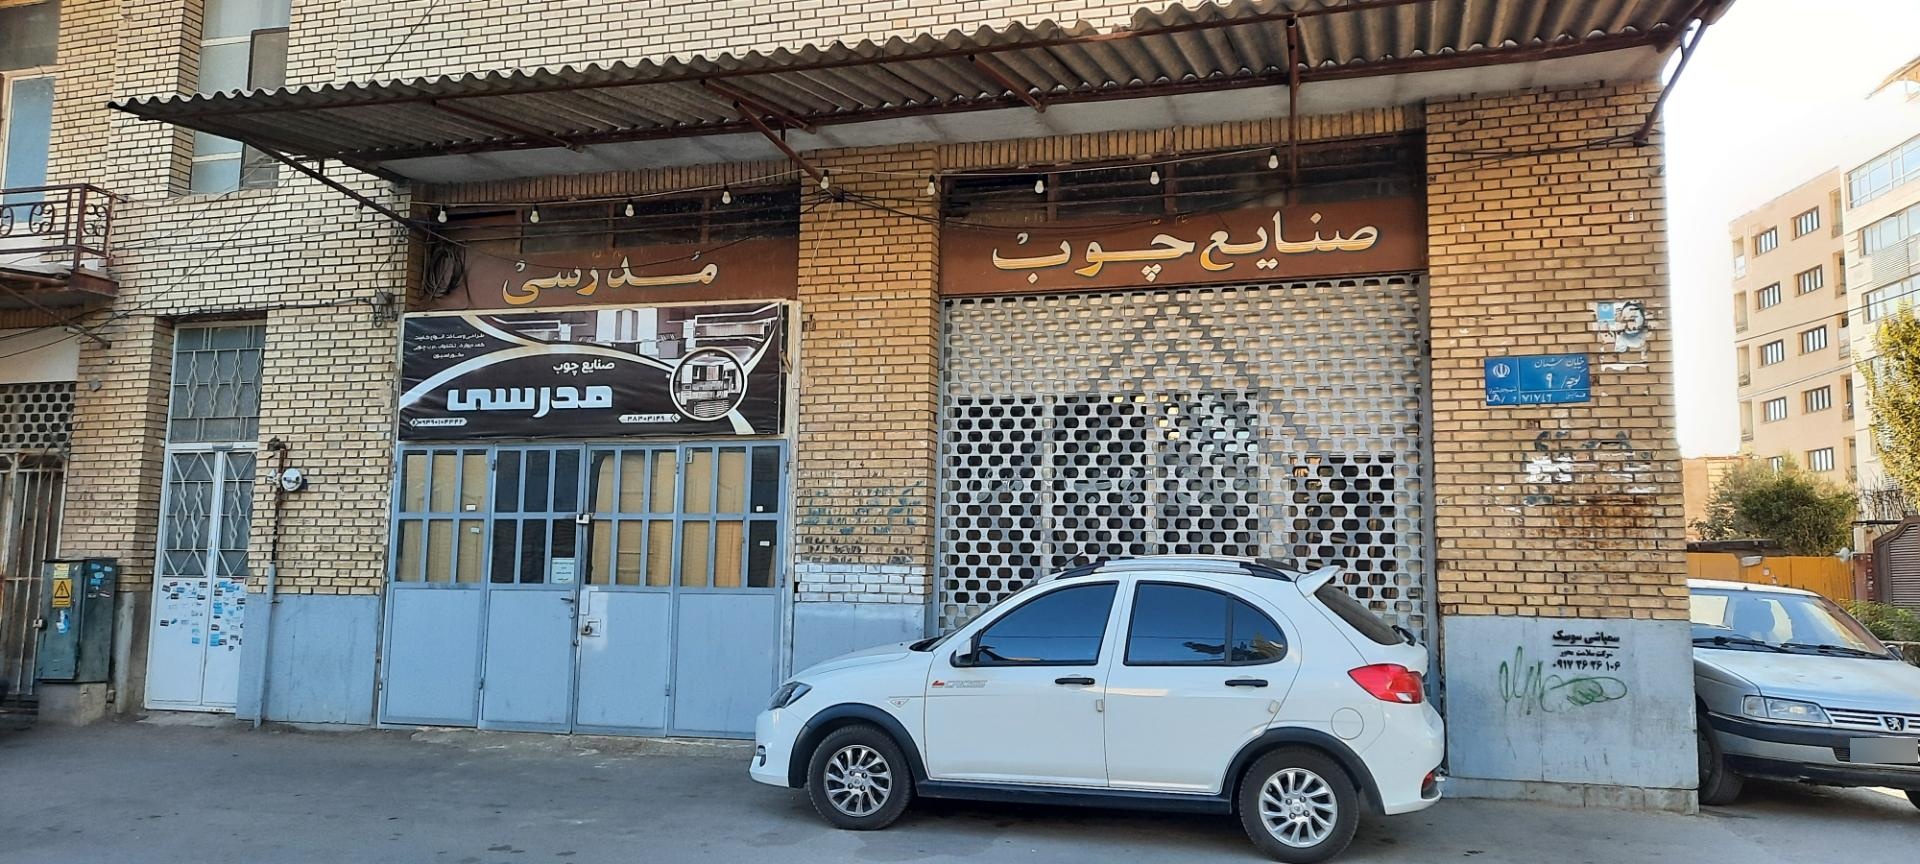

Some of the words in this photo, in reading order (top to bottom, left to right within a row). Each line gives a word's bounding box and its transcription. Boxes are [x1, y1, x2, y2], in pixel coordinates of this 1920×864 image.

[1199, 211, 1380, 272] صنایع
[992, 232, 1197, 284] چوب
[552, 362, 580, 377] چوب
[582, 358, 616, 374] صنایع
[447, 385, 613, 417] مدرسی
